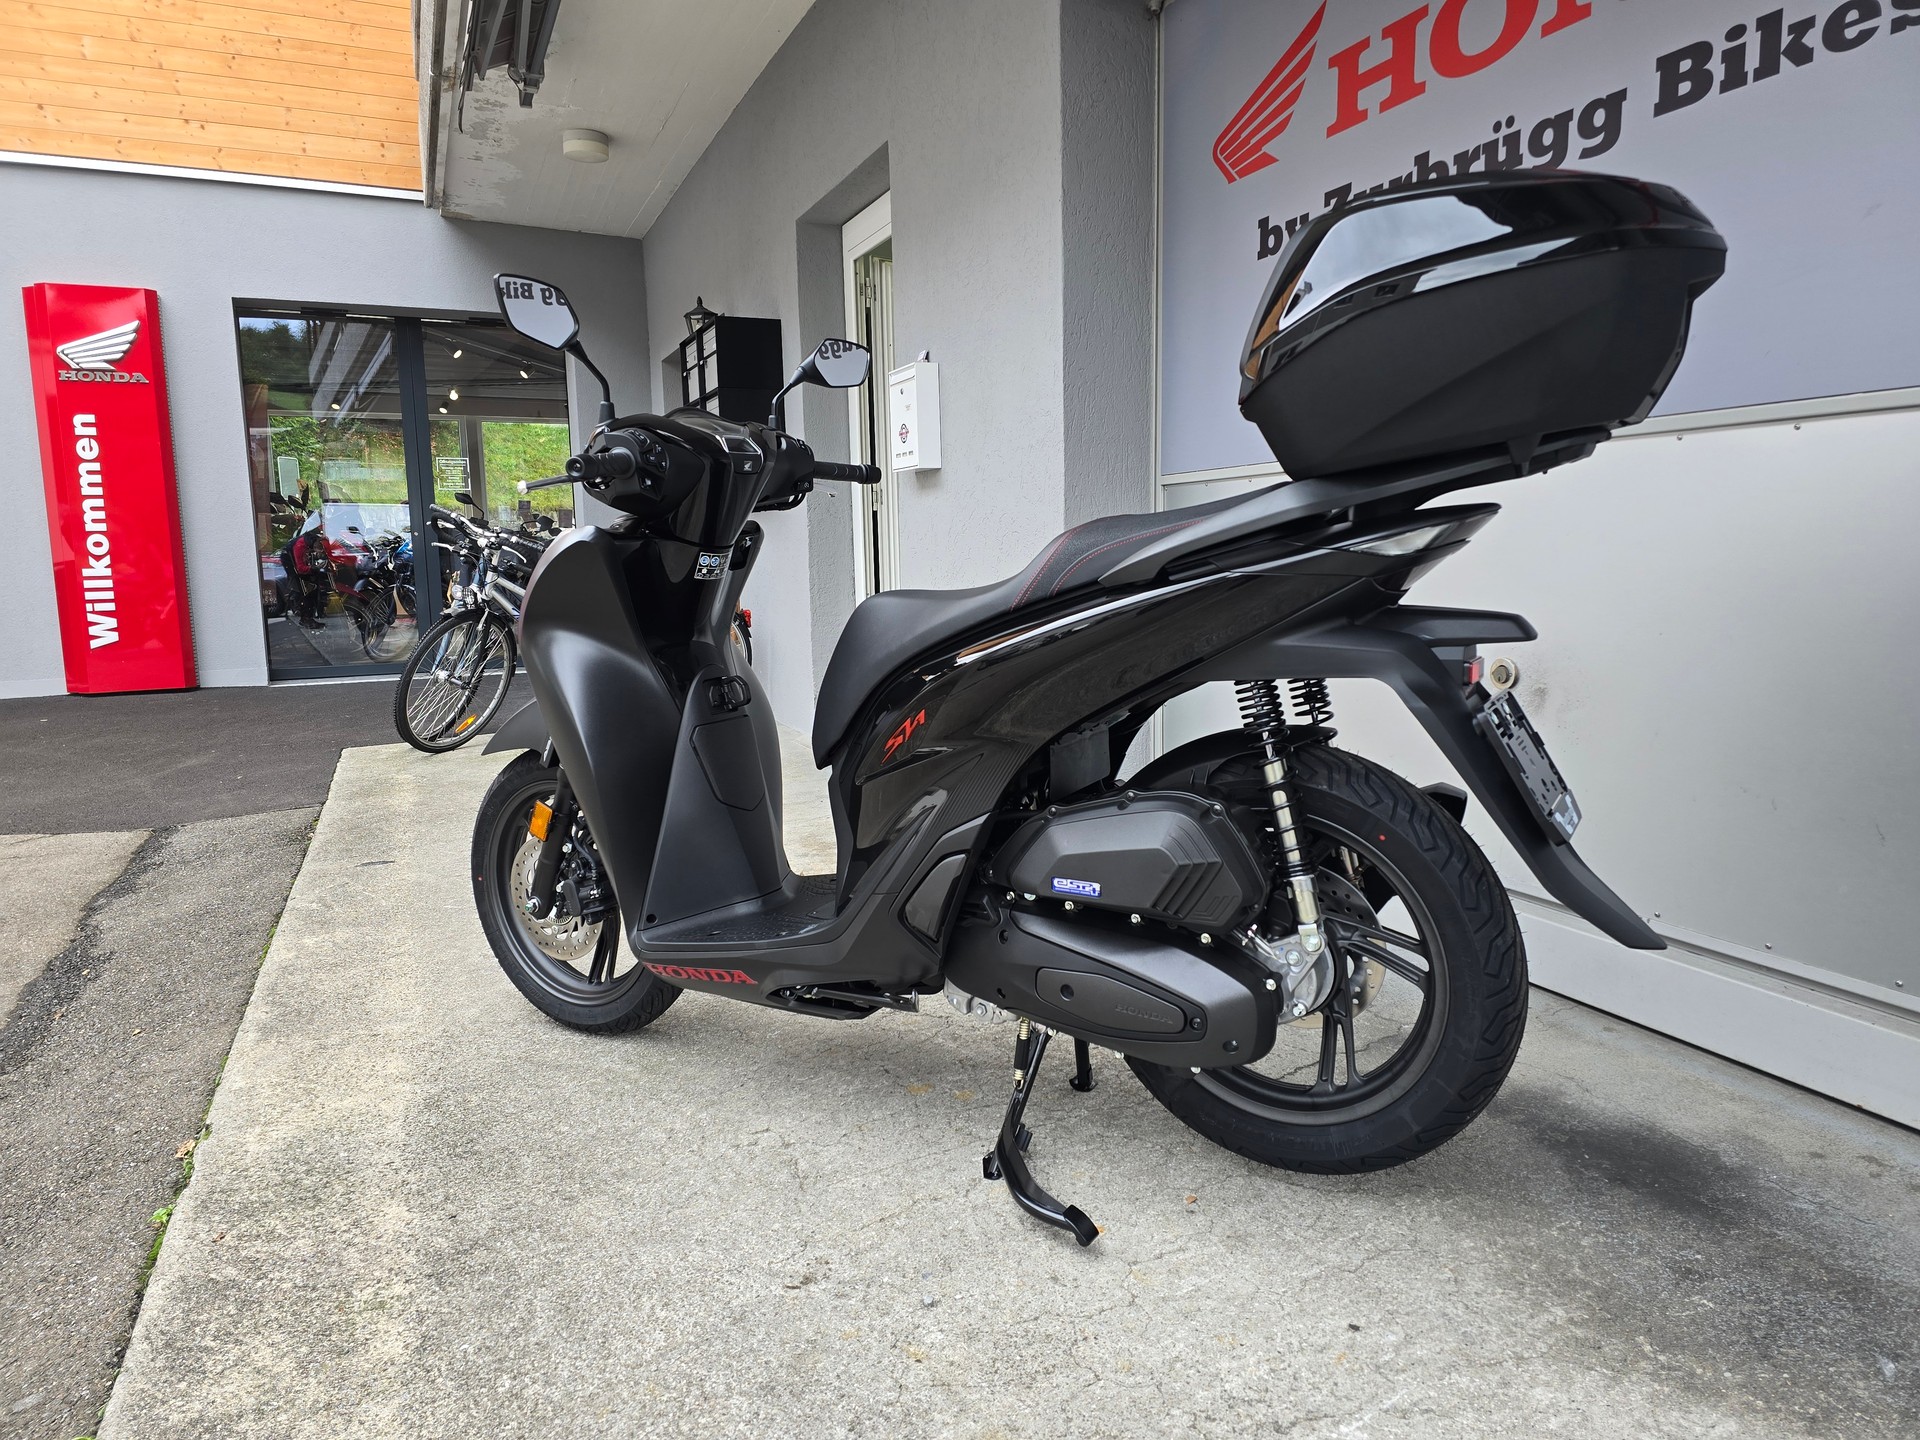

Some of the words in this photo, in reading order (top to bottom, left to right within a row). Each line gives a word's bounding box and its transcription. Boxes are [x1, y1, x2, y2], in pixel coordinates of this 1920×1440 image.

[58, 370, 149, 383] HONDA
[72, 413, 120, 650] Willkommen
[642, 961, 759, 985] HONDA
